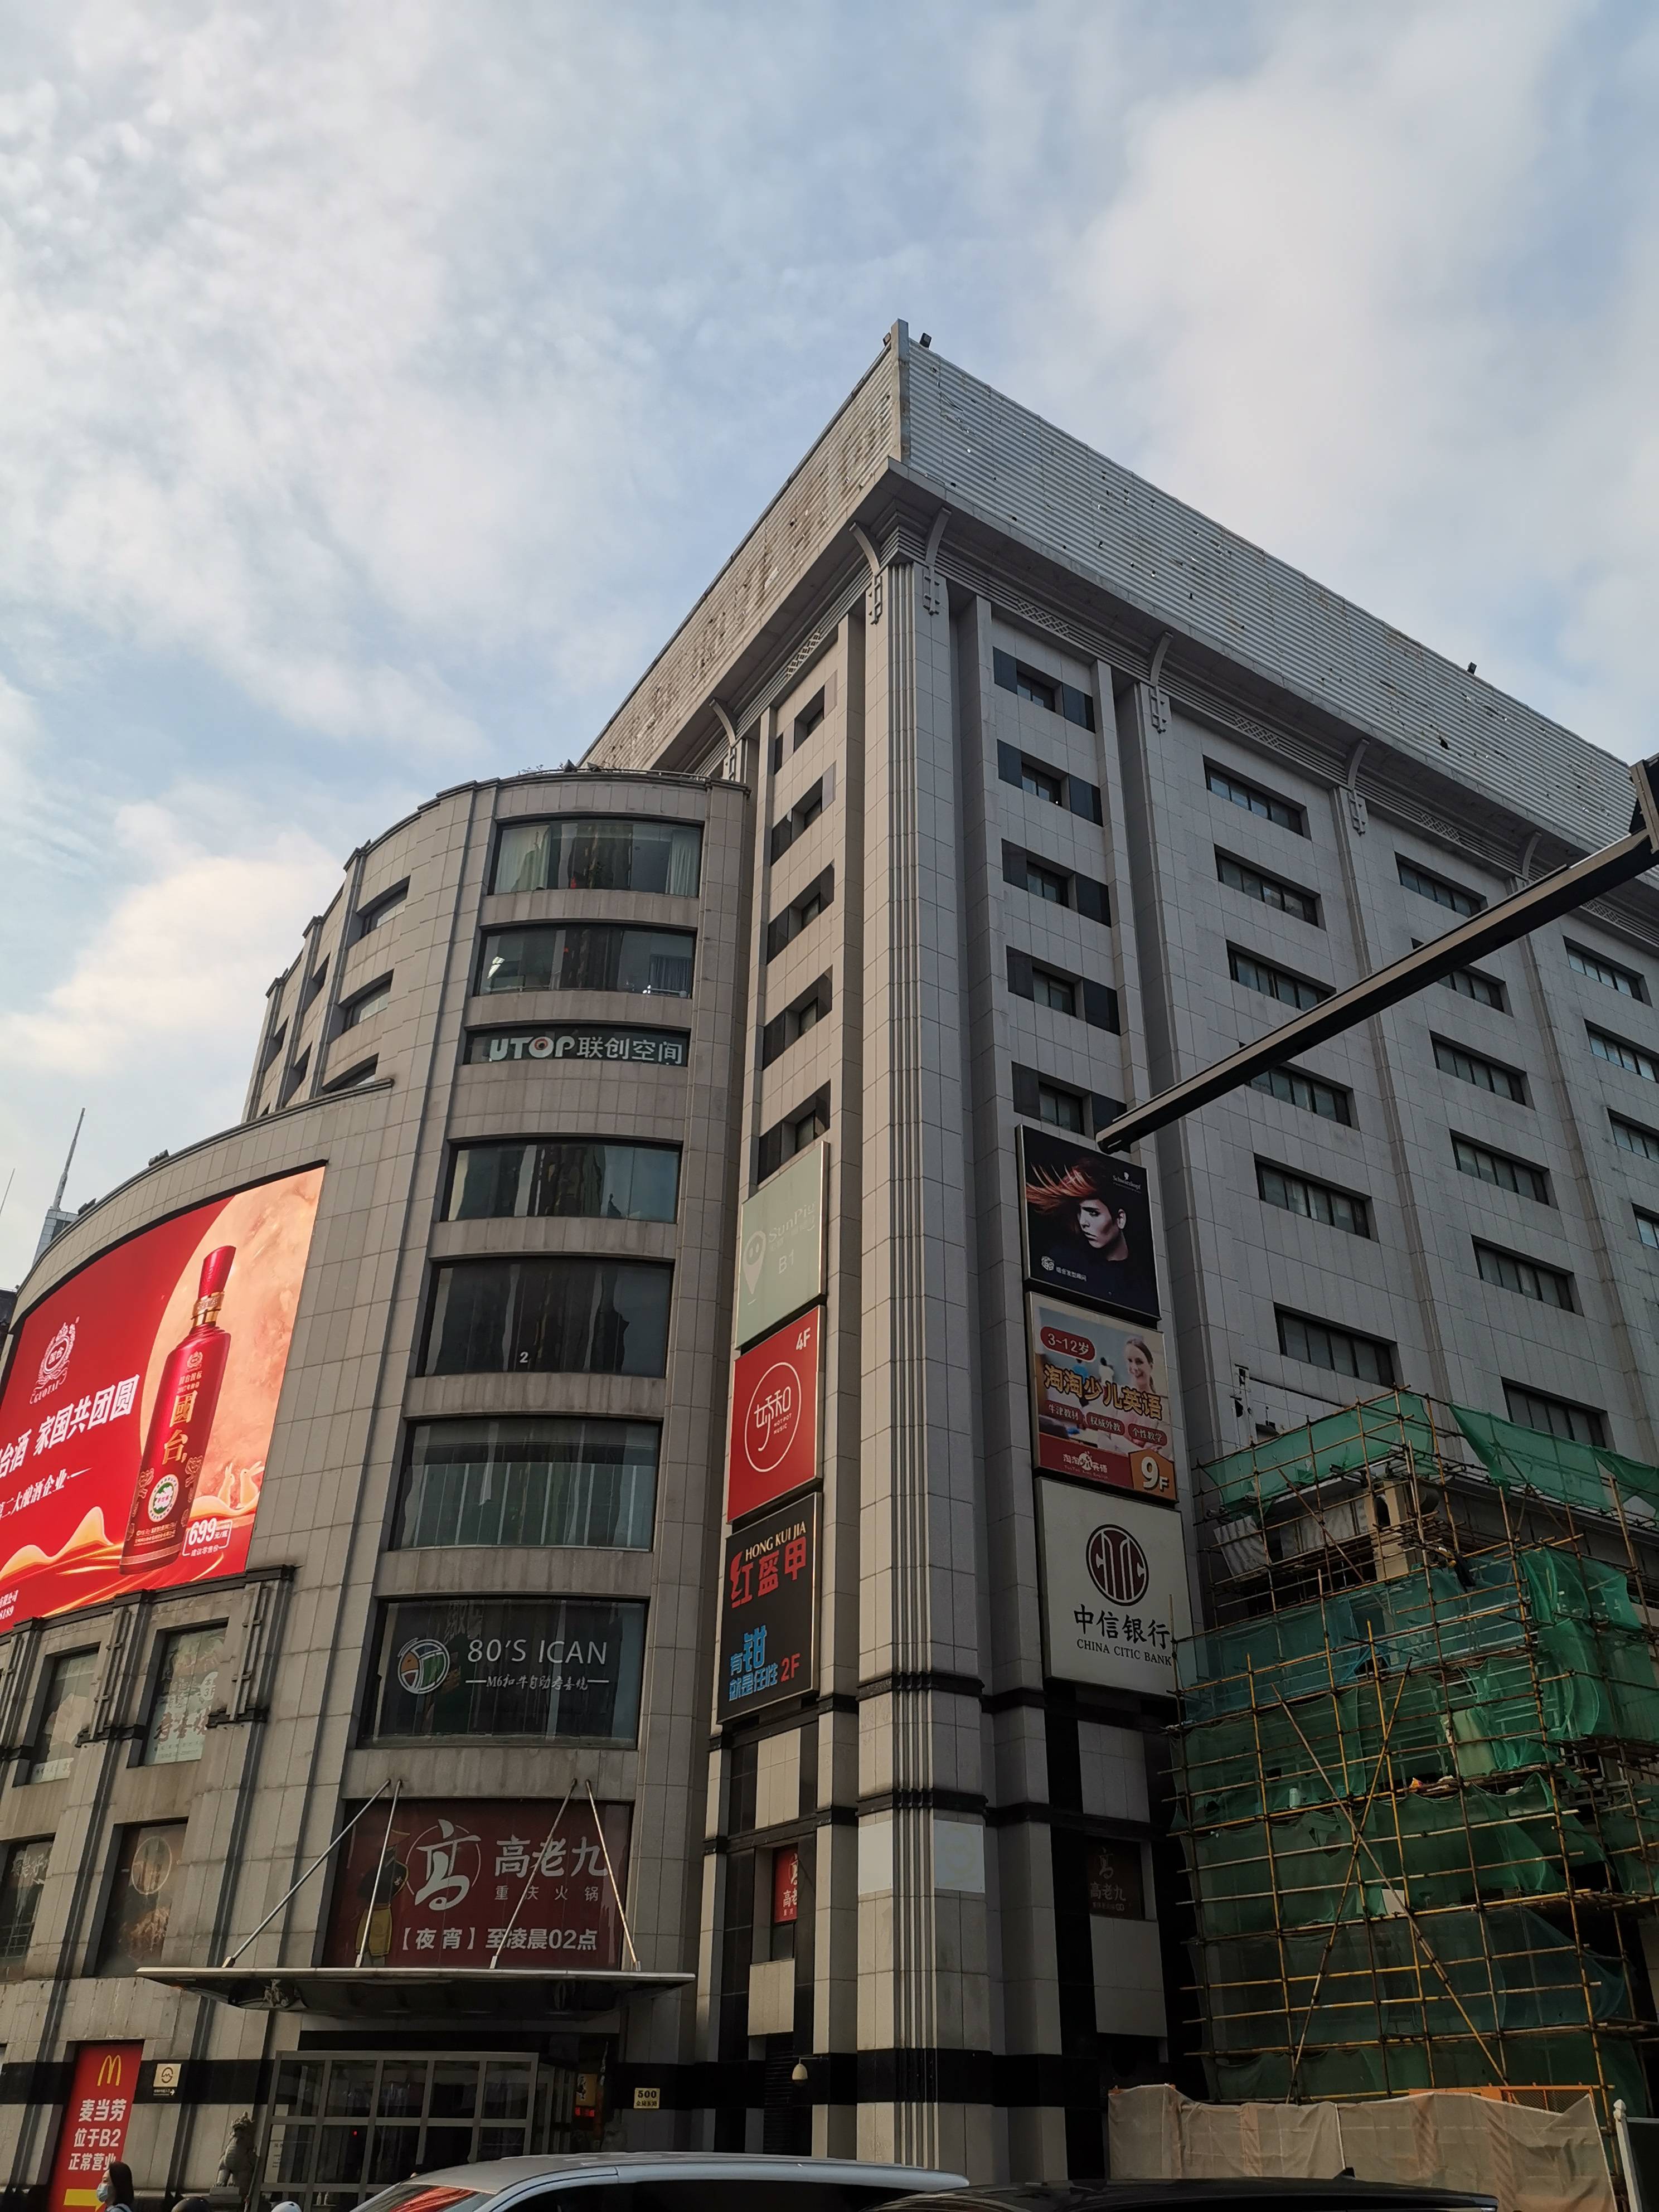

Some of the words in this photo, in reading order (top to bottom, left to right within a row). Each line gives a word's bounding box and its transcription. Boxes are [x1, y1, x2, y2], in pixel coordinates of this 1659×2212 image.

[779, 1248, 794, 1274] B1
[795, 1327, 811, 1350] 4F
[519, 1351, 529, 1364] 2
[33, 1380, 60, 1403] GUOTAI
[1044, 1363, 1162, 1420] 淘淘少儿英语
[33, 1374, 140, 1456] 家国共团圆
[1049, 1404, 1079, 1421] 牛津教材
[1090, 1416, 1122, 1433] 权威外教
[1132, 1427, 1163, 1443] 个性教学
[1141, 1456, 1170, 1490] 9F
[745, 1536, 774, 1562] HONG
[775, 1527, 792, 1547] KUI
[793, 1520, 807, 1541] JIA
[730, 1536, 807, 1609] 红盔甲
[1073, 1603, 1171, 1650] 中信银行
[538, 1640, 608, 1665] ICAN
[1076, 1638, 1110, 1655] CHINA
[1114, 1646, 1141, 1660] CITIC
[1144, 1652, 1172, 1666] BANK
[780, 1652, 801, 1682] 2F
[728, 1662, 779, 1701] 就是任性
[494, 1834, 609, 1879] 高老九
[494, 1885, 600, 1901] 重庆火锅
[1090, 1881, 1127, 1901] 高老九
[637, 2089, 657, 2098] 500
[79, 2098, 127, 2122] 麦当劳
[73, 2128, 122, 2148] 位于B2
